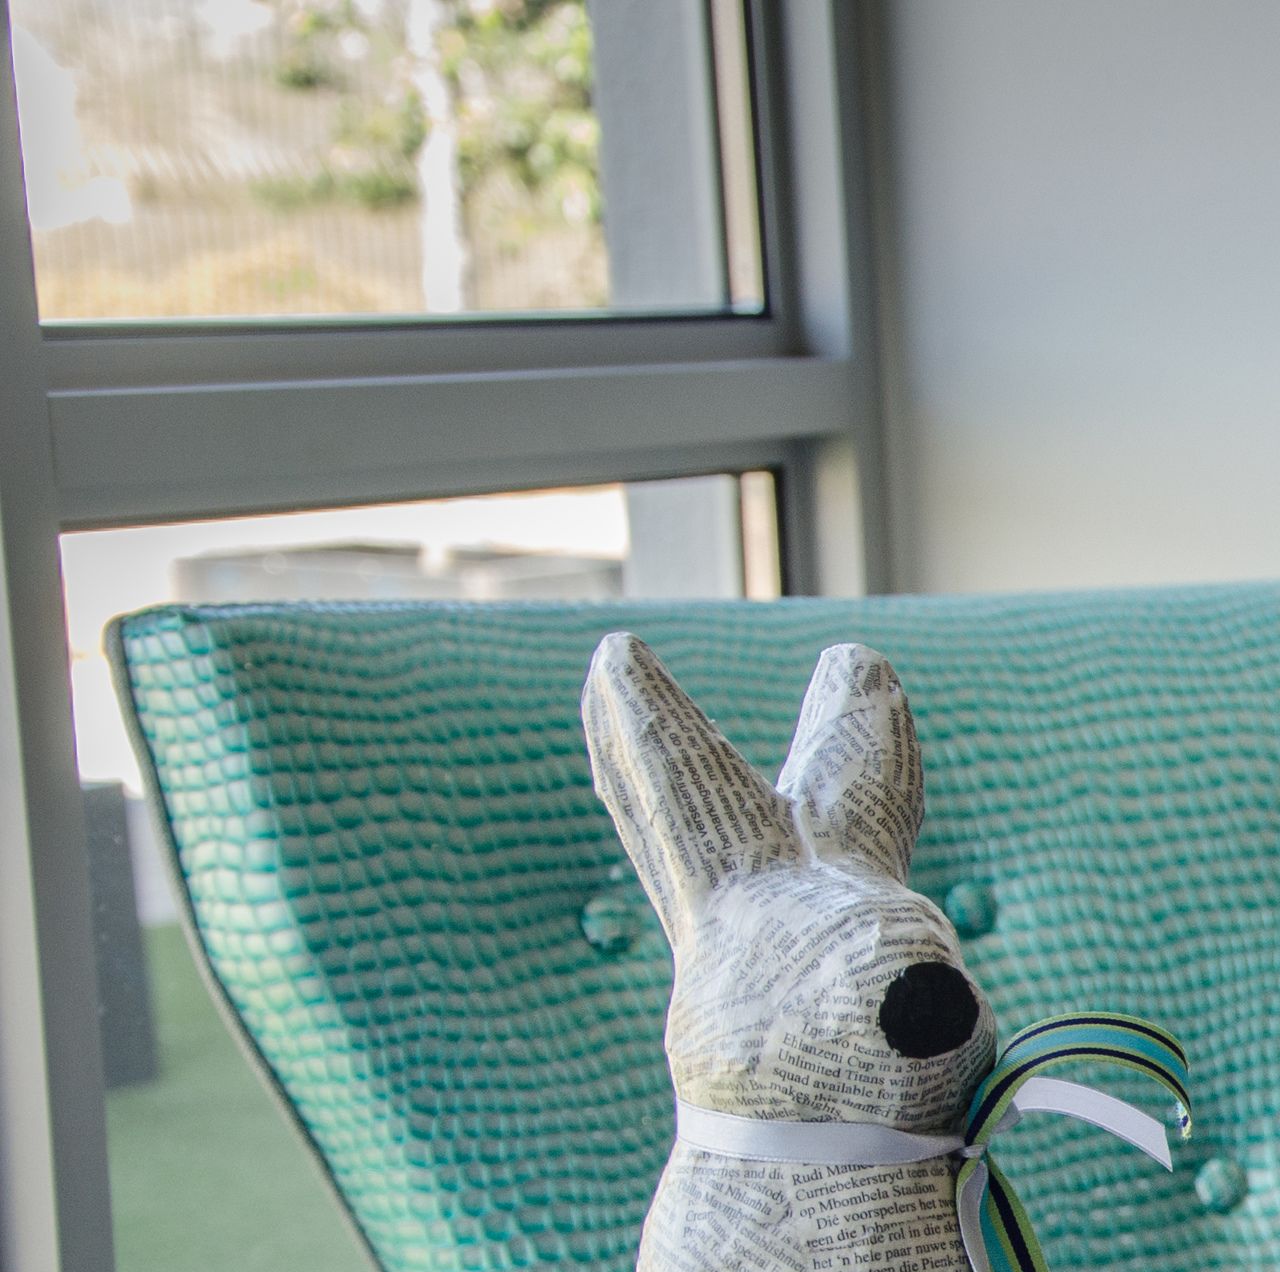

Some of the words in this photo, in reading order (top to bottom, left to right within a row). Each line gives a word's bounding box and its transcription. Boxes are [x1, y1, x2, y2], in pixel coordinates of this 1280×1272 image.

[820, 1187, 889, 1211] Mbombela
[844, 1201, 916, 1222] voorspelers
[813, 1257, 832, 1270] het
